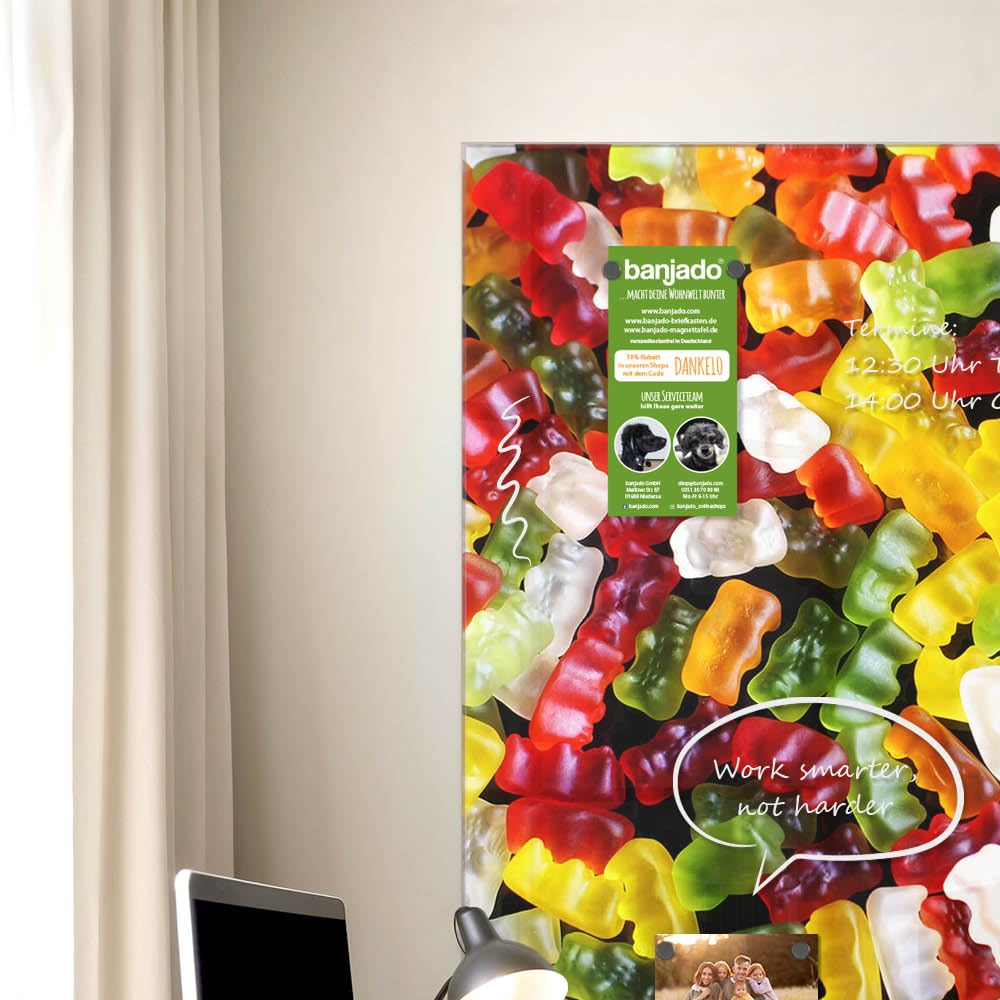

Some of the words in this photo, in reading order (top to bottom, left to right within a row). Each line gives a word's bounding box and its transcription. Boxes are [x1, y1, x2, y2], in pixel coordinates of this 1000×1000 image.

[624, 258, 723, 287] banjado
[625, 317, 718, 326] www.banjado-briefkasten.de
[641, 308, 701, 316] www.banjado.com
[624, 326, 718, 335] www.banjado-magnettafel.de
[844, 320, 958, 338] Termine:
[674, 356, 723, 376] DANKE10
[844, 356, 922, 375] 12:30
[932, 356, 982, 375] Uhr
[932, 391, 982, 411] Uhr
[714, 756, 790, 781] Work
[800, 759, 917, 783] smarter,
[738, 797, 785, 817] not
[795, 793, 894, 817] harder
